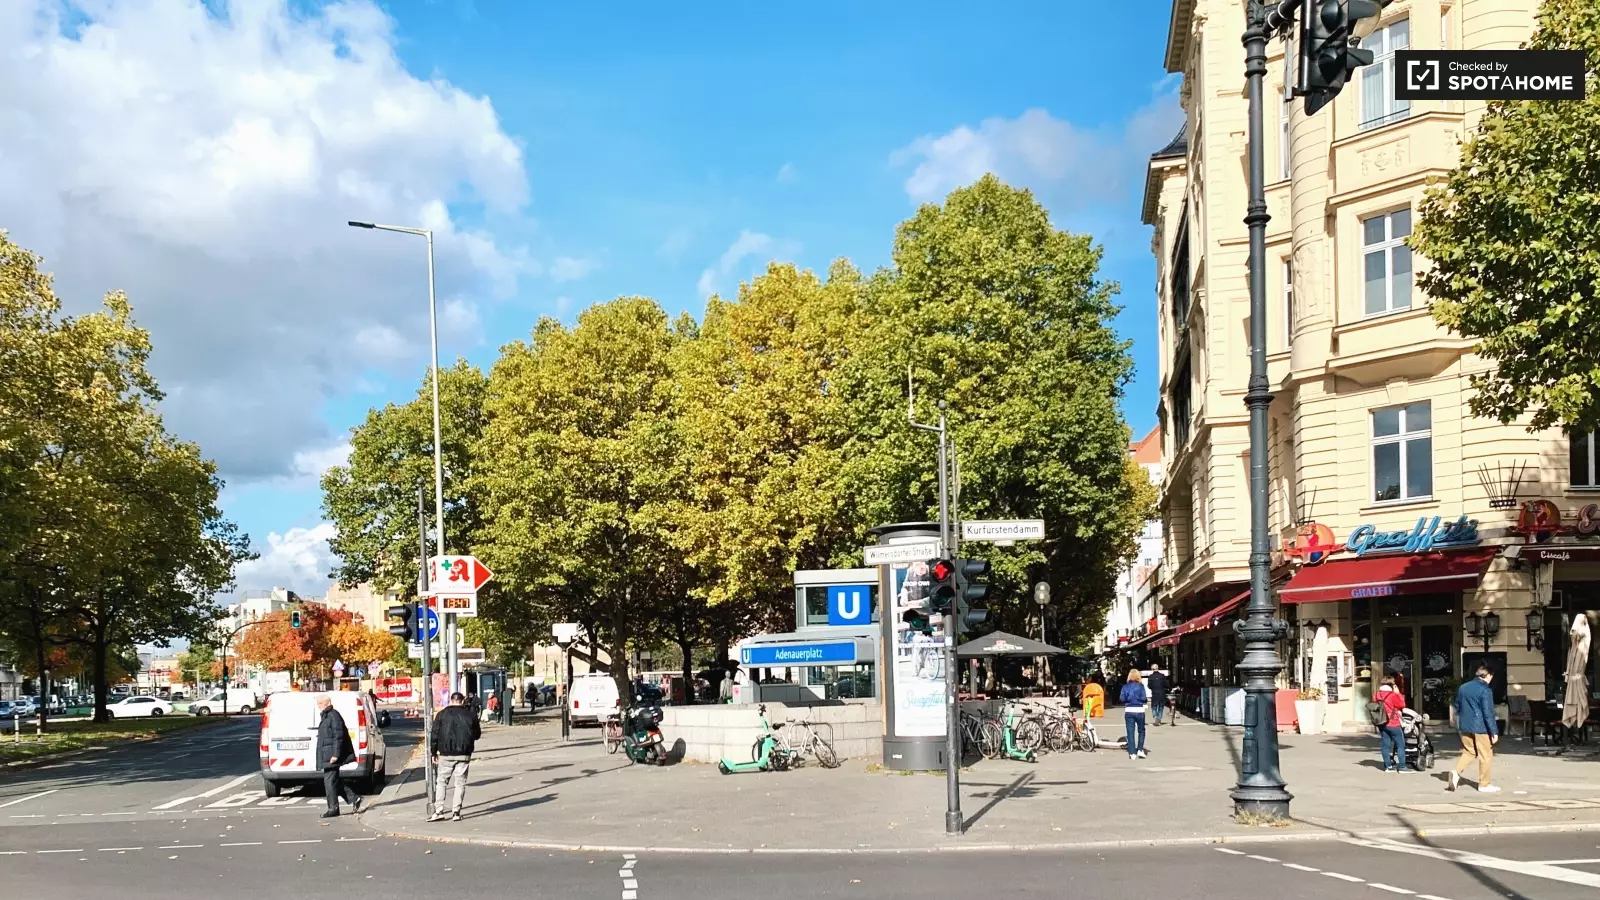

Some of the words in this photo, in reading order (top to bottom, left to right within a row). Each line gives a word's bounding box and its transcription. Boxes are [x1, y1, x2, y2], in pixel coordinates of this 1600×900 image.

[967, 523, 1040, 535] Kurfürstendamm
[1346, 513, 1480, 556] Graffiti
[869, 548, 912, 559] Wilmersdorfer
[912, 546, 933, 557] Straße
[1540, 550, 1571, 561] Eiscafé
[837, 591, 861, 620] U
[742, 649, 750, 663] U
[775, 647, 823, 661] Adenauerplatz
